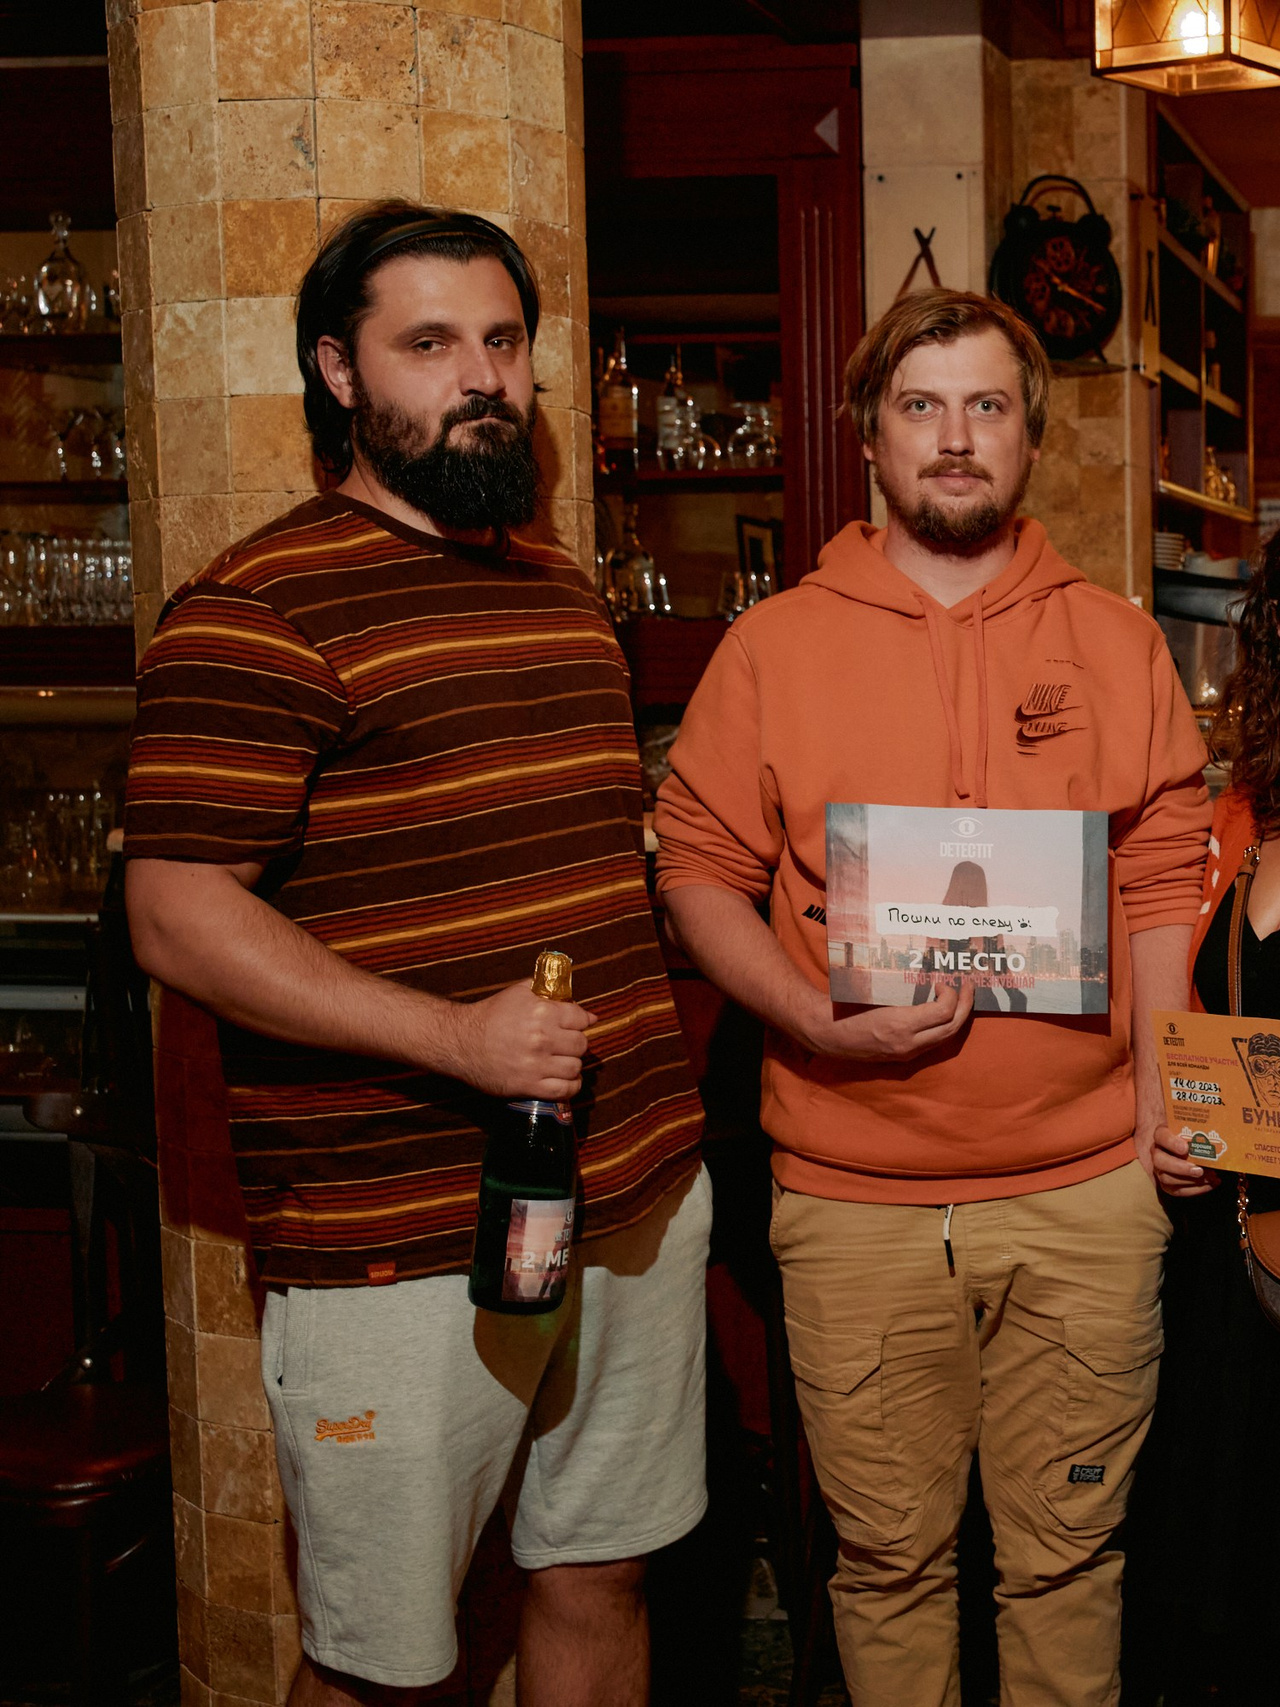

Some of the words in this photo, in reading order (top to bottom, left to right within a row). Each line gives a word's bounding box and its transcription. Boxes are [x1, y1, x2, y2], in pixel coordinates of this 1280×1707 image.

[939, 841, 994, 859] DETECTIT
[887, 907, 942, 925] Пошли
[948, 916, 966, 927] по
[972, 917, 1013, 932] следу
[908, 949, 923, 969] 2
[934, 951, 1026, 973] МЕСТО
[521, 1251, 536, 1269] 2
